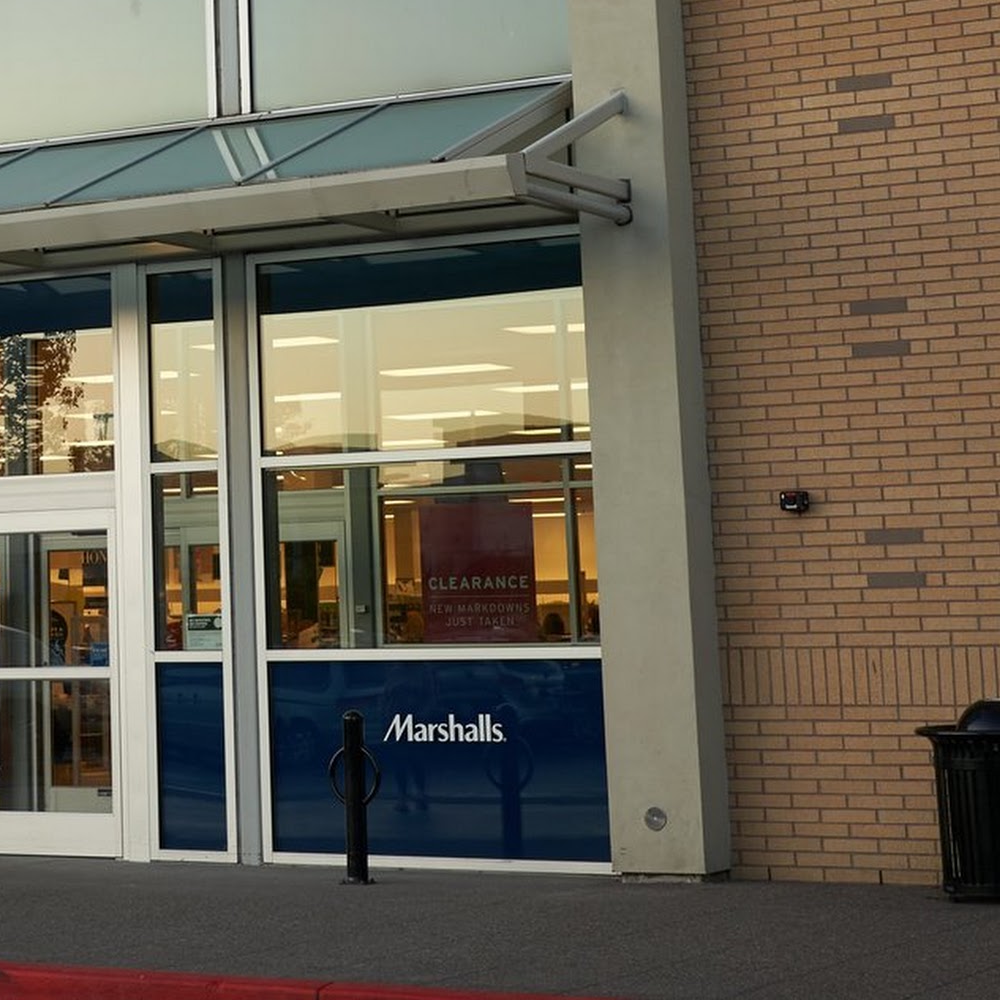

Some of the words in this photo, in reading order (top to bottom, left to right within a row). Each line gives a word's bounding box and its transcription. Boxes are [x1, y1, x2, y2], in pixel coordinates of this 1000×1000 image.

[428, 575, 529, 590] CLEARANCE
[430, 602, 453, 614] NEW
[457, 602, 531, 614] MARKDOWNS
[445, 616, 473, 627] JUST
[479, 616, 515, 627] TAKEN
[383, 714, 504, 742] Marshalls
